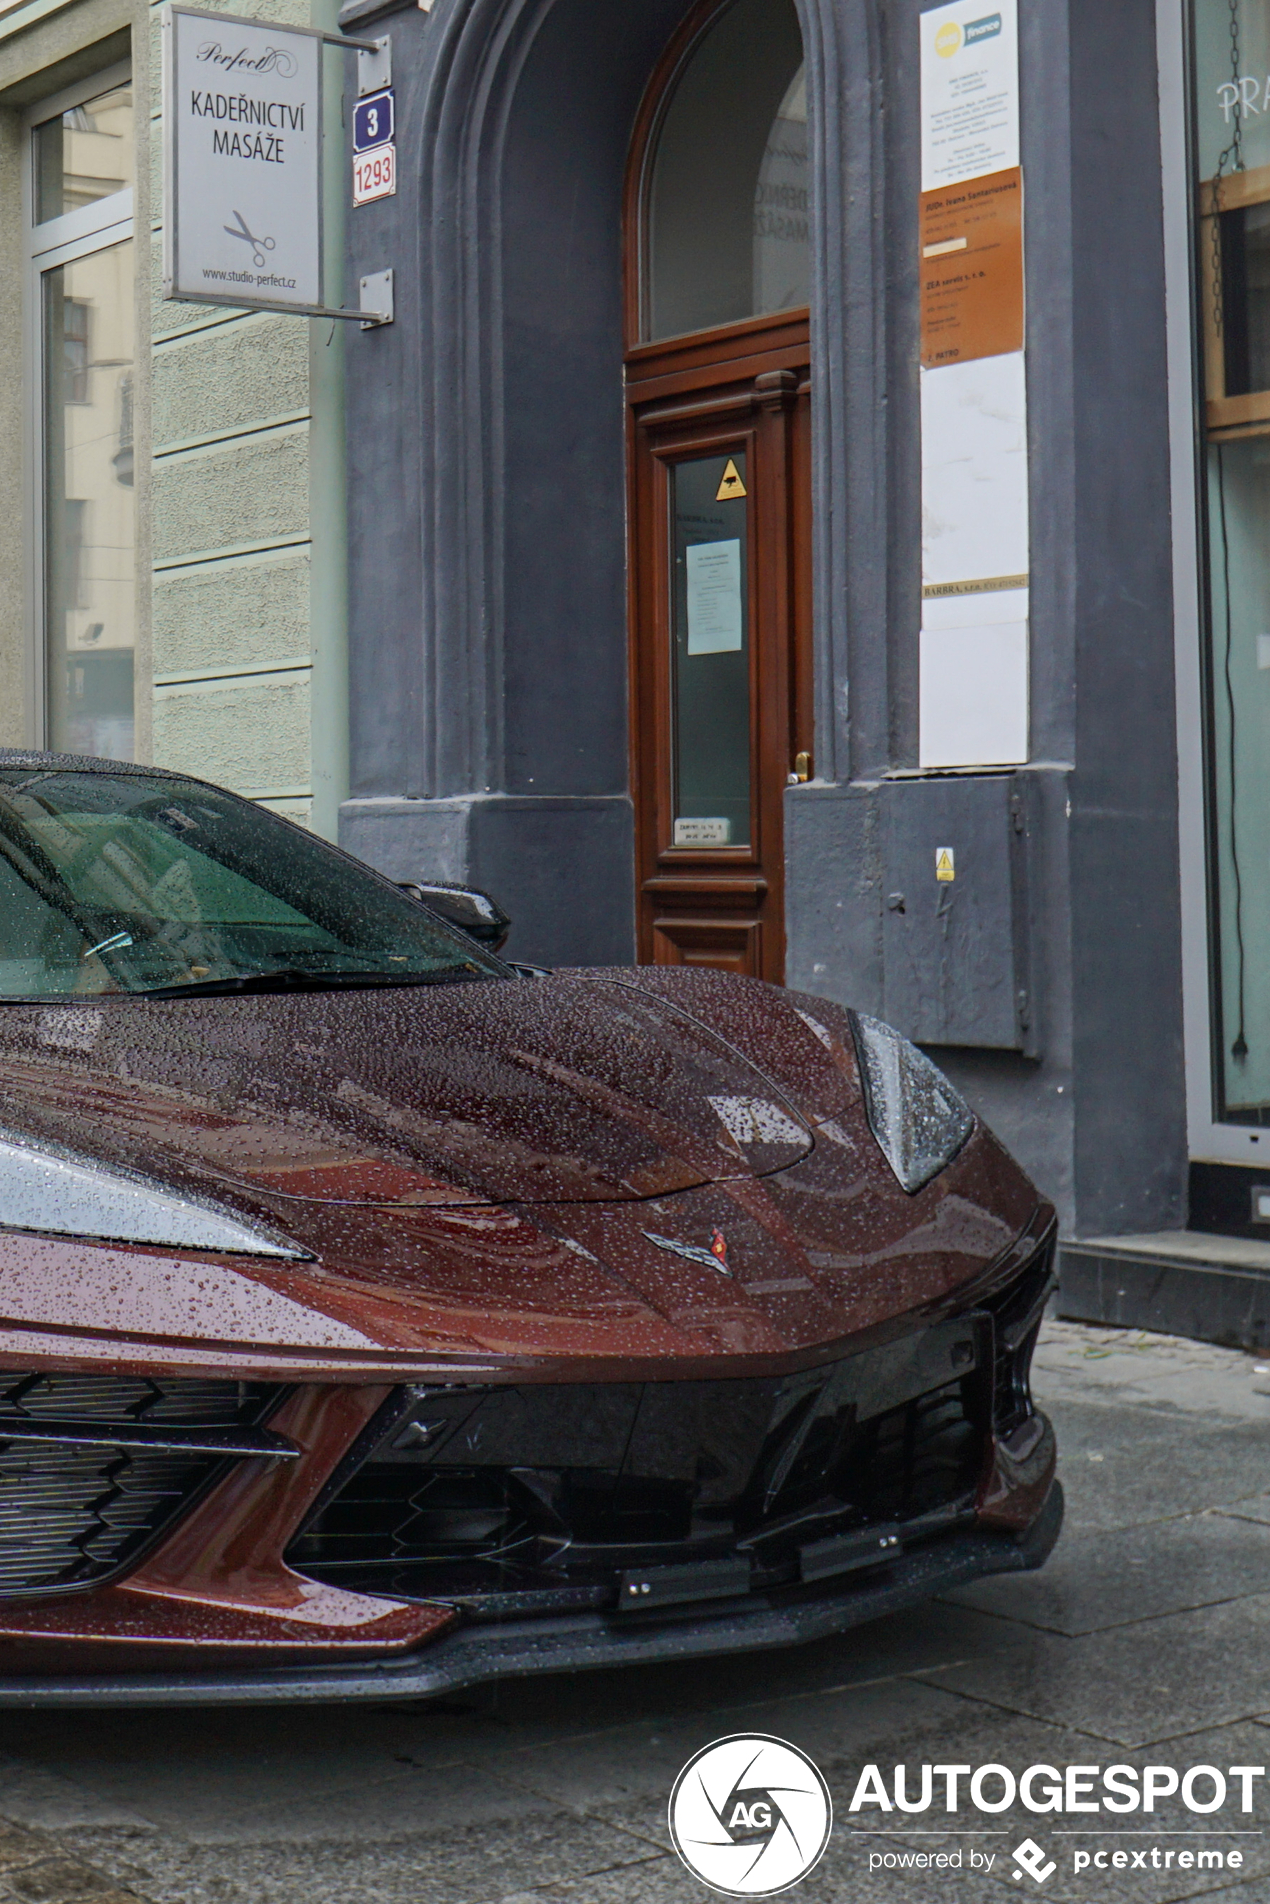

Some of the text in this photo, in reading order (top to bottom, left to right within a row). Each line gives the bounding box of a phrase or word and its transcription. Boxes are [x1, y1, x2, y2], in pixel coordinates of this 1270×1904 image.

[196, 41, 298, 79] Perfect
[191, 90, 305, 132] KADEŘNICTVÍ
[367, 109, 379, 137] 3
[213, 129, 284, 164] MASÁŽE
[356, 157, 391, 192] 1293
[202, 268, 297, 289] www.studio-perfect.cz
